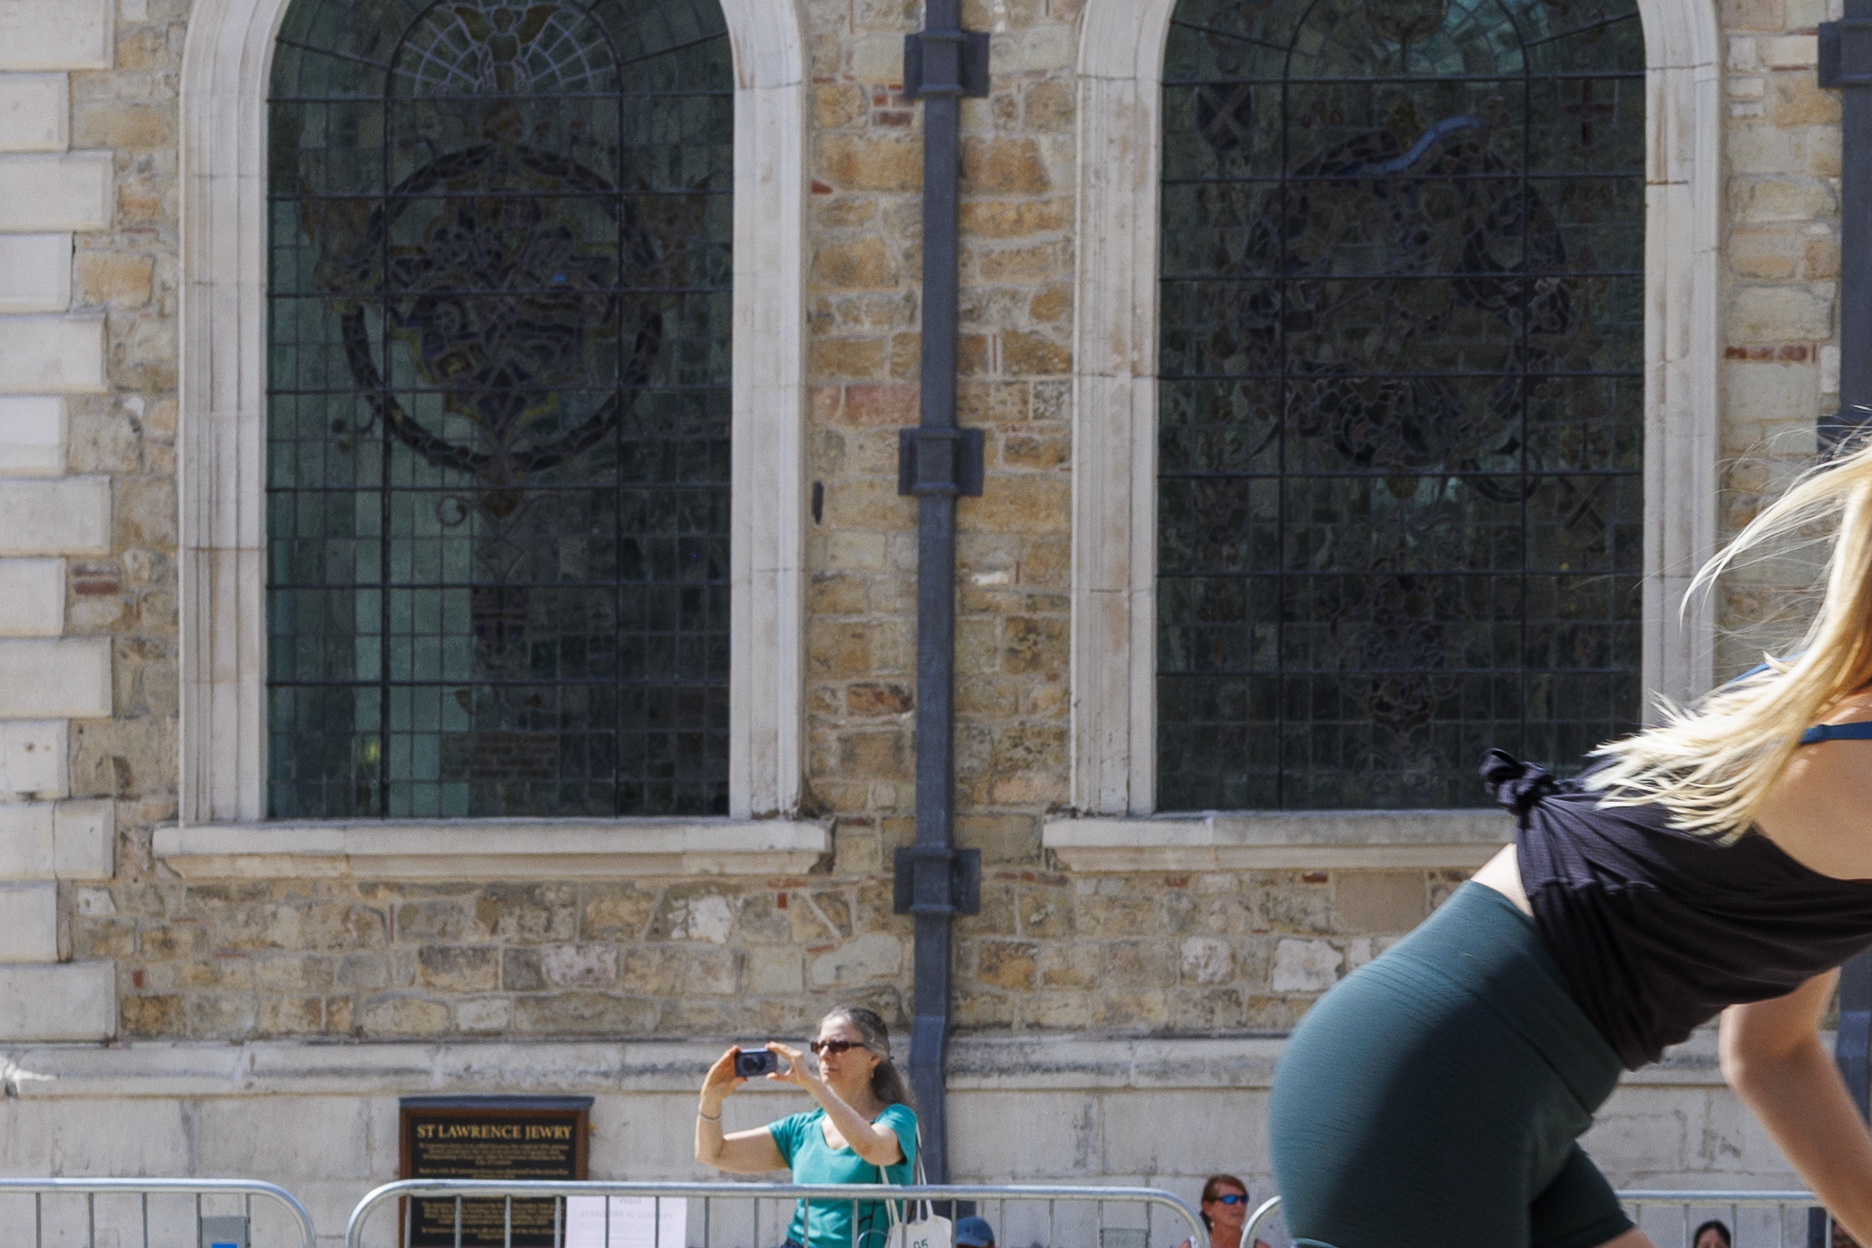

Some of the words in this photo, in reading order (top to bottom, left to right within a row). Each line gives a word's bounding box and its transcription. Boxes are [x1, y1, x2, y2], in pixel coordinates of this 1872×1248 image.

[416, 1123, 436, 1138] ST
[438, 1124, 522, 1139] LAWRENCE
[525, 1125, 572, 1140] JEWRY
